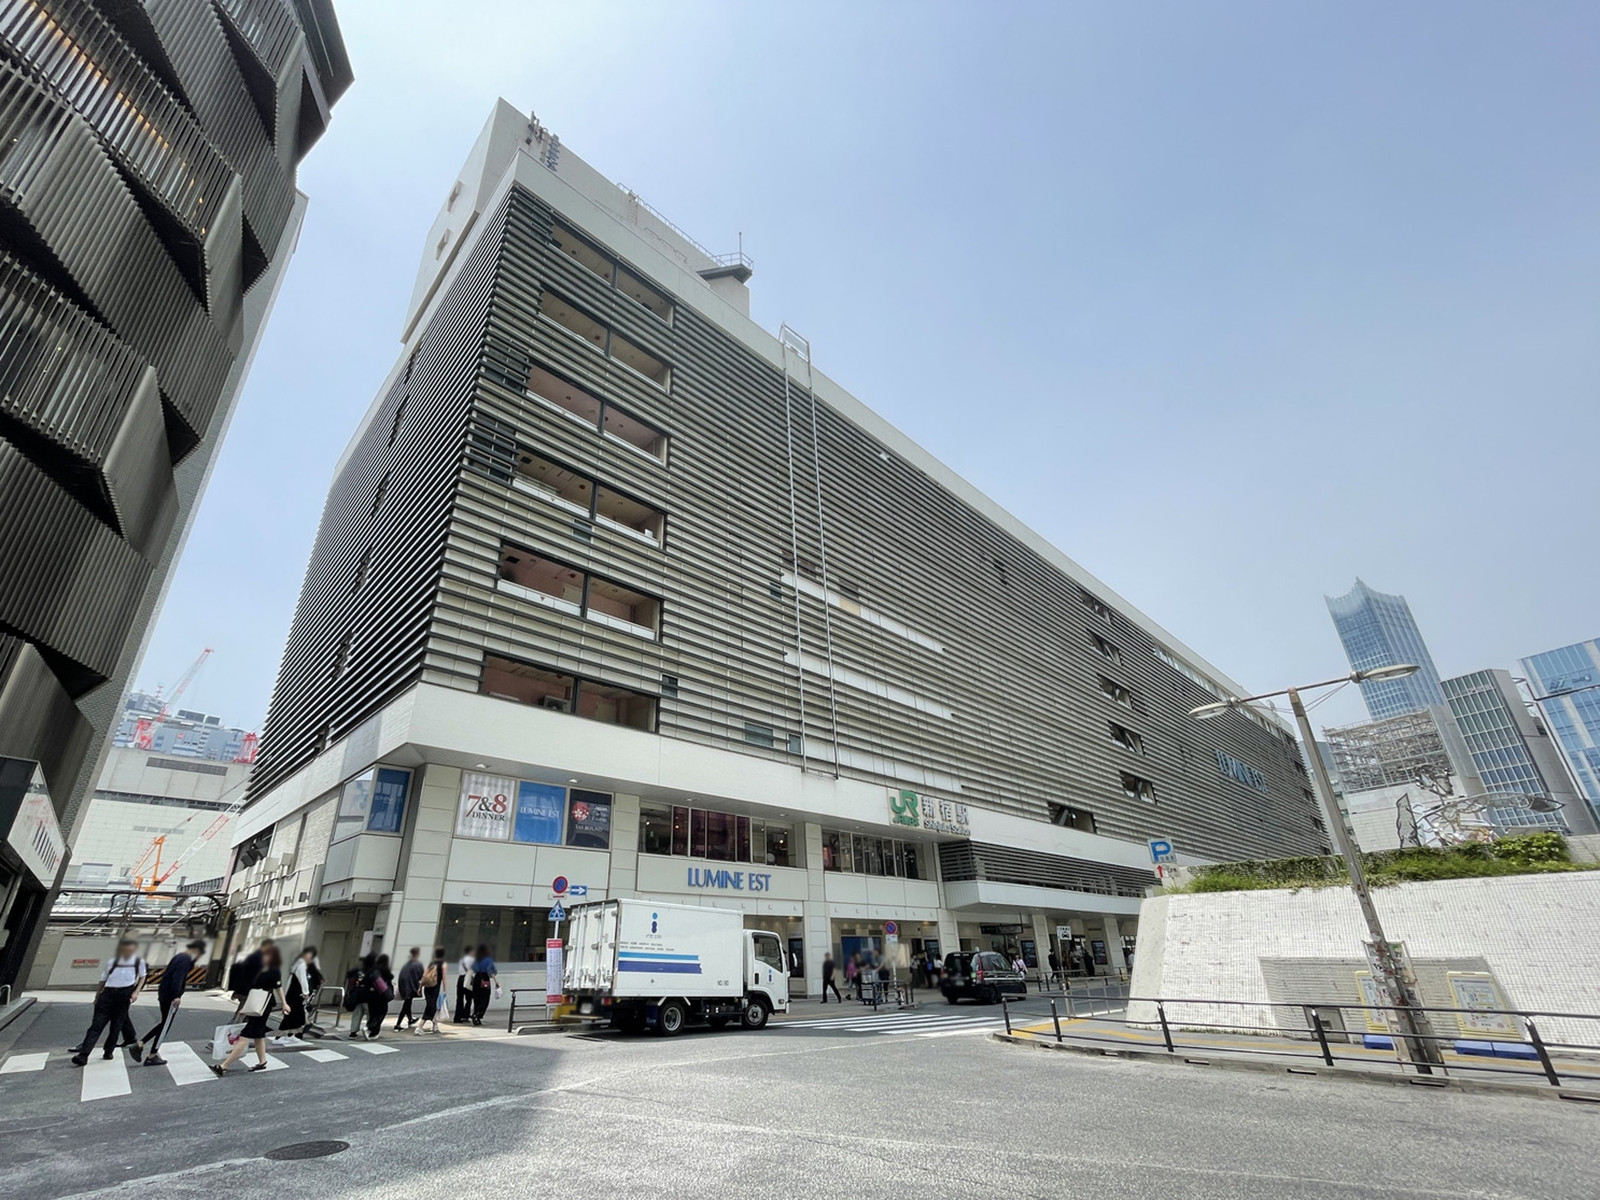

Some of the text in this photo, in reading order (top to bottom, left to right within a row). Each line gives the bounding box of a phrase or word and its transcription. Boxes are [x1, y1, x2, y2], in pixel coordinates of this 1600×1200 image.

[466, 793, 507, 817] 7&8
[890, 789, 919, 817] JR
[921, 796, 969, 824] 新宿駅
[472, 811, 505, 821] DINNER
[1151, 841, 1171, 862] P
[688, 868, 772, 892] LUMINE EST
